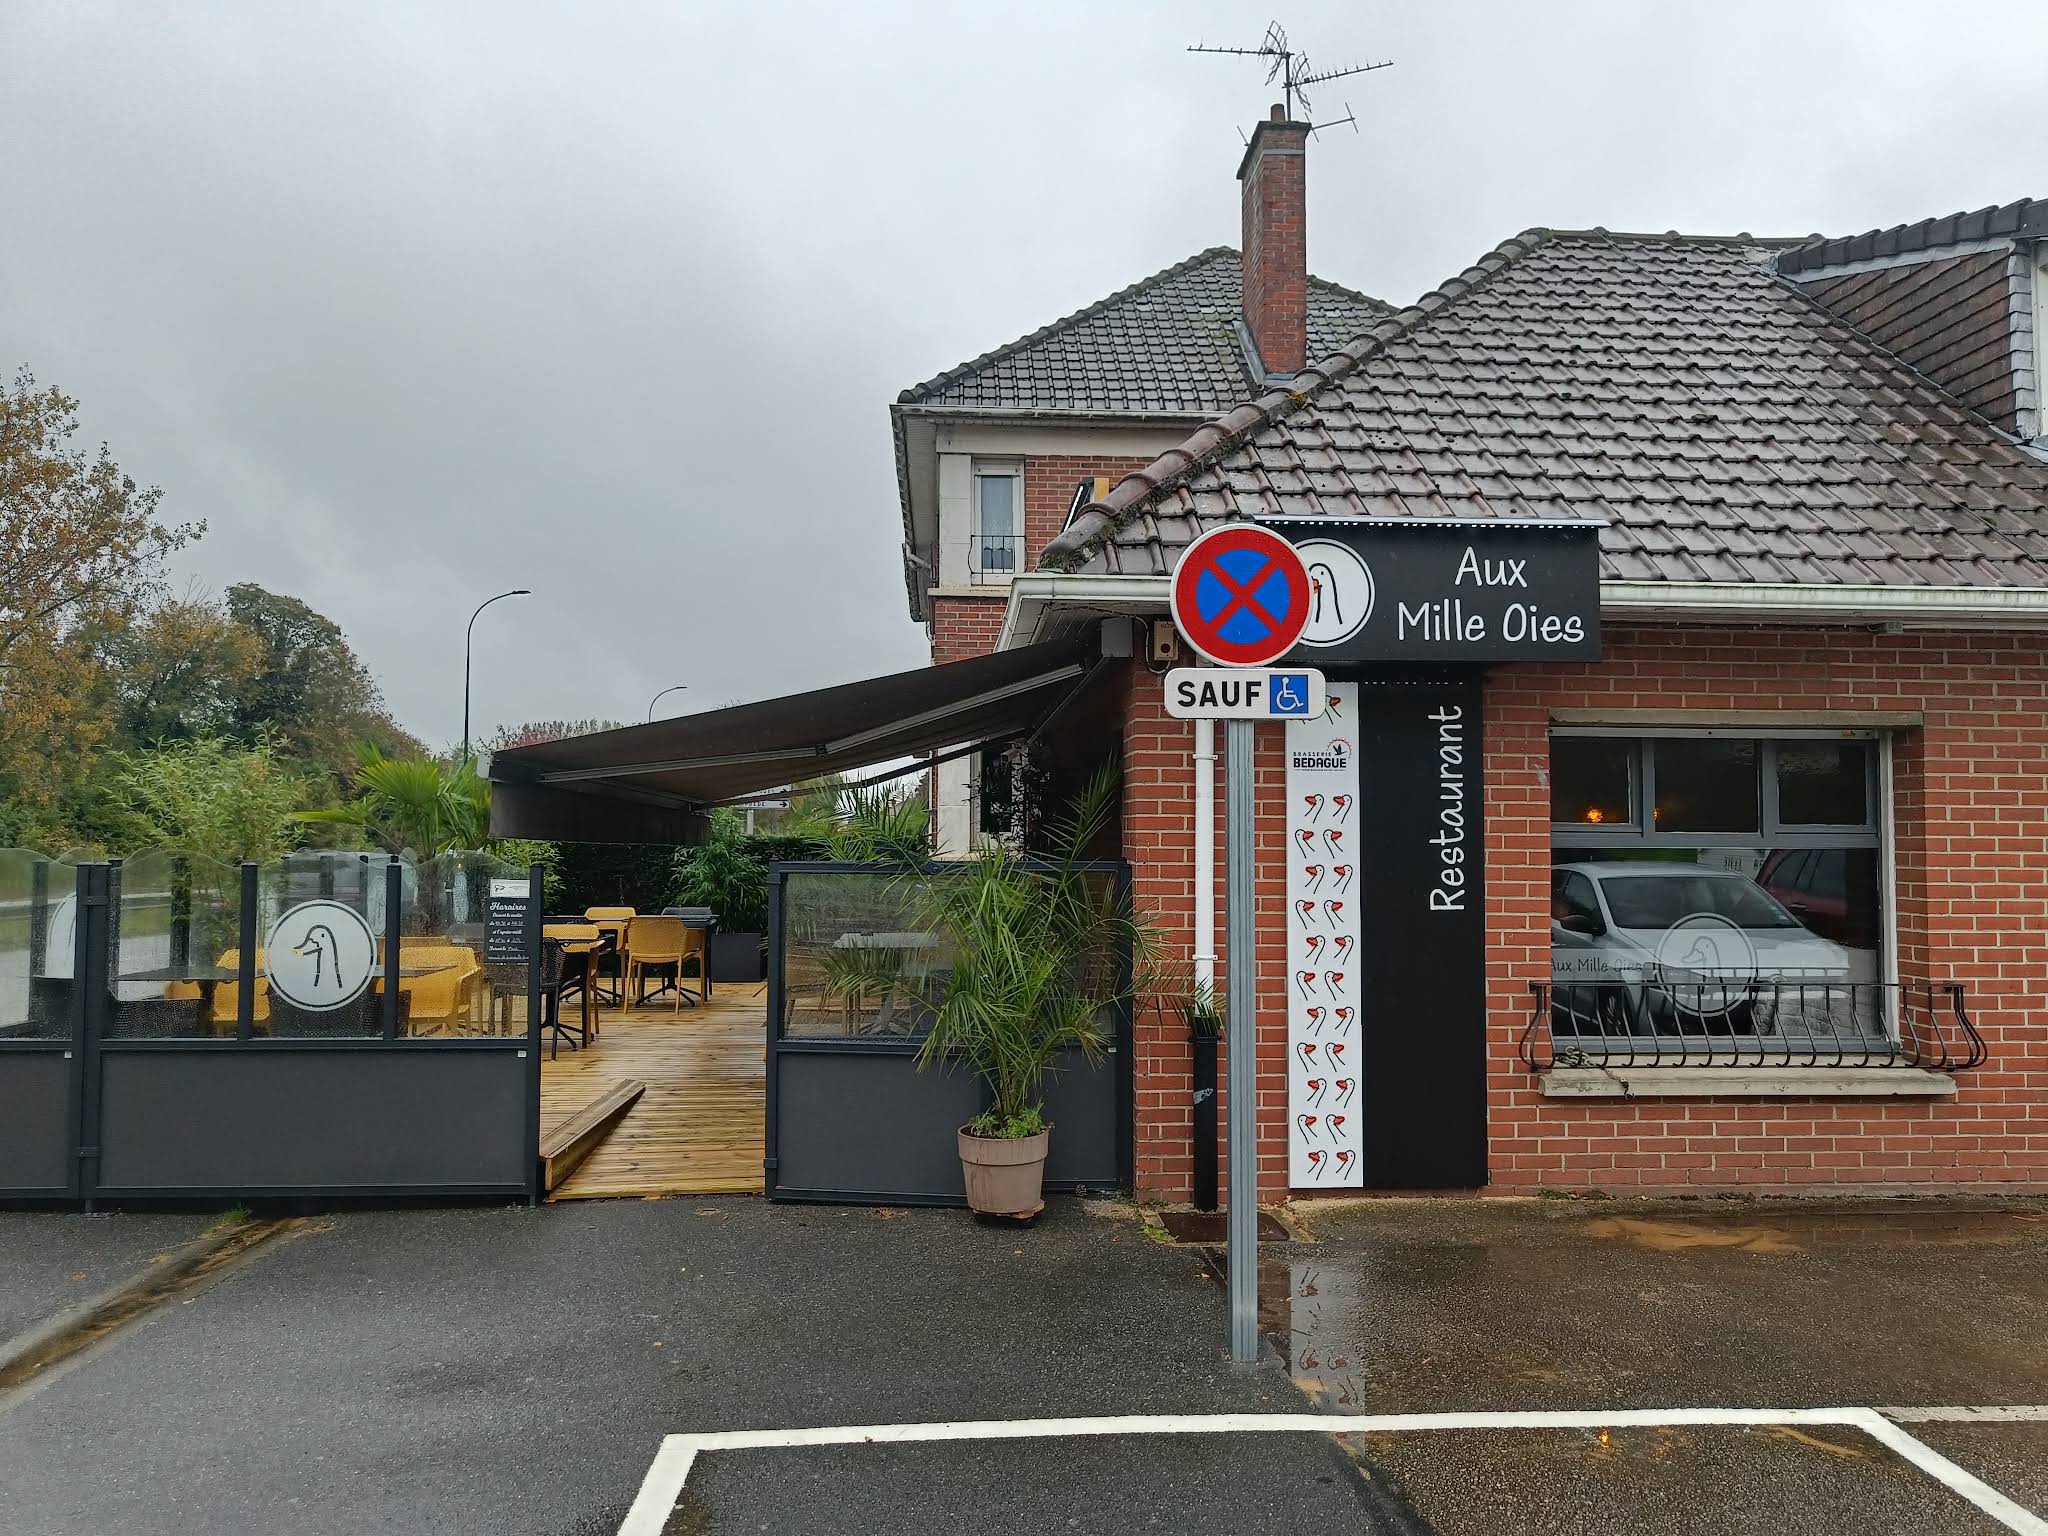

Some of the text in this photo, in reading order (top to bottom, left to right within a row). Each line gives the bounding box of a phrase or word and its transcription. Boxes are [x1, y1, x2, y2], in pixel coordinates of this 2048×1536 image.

[1454, 546, 1528, 588] Aux
[1398, 598, 1585, 643] Mille Oies
[1177, 680, 1262, 708] SAUF
[1293, 757, 1347, 768] BEDAGUE
[1428, 705, 1466, 911] Restaurant
[489, 901, 527, 911] Horaires
[1577, 957, 1609, 973] Mille
